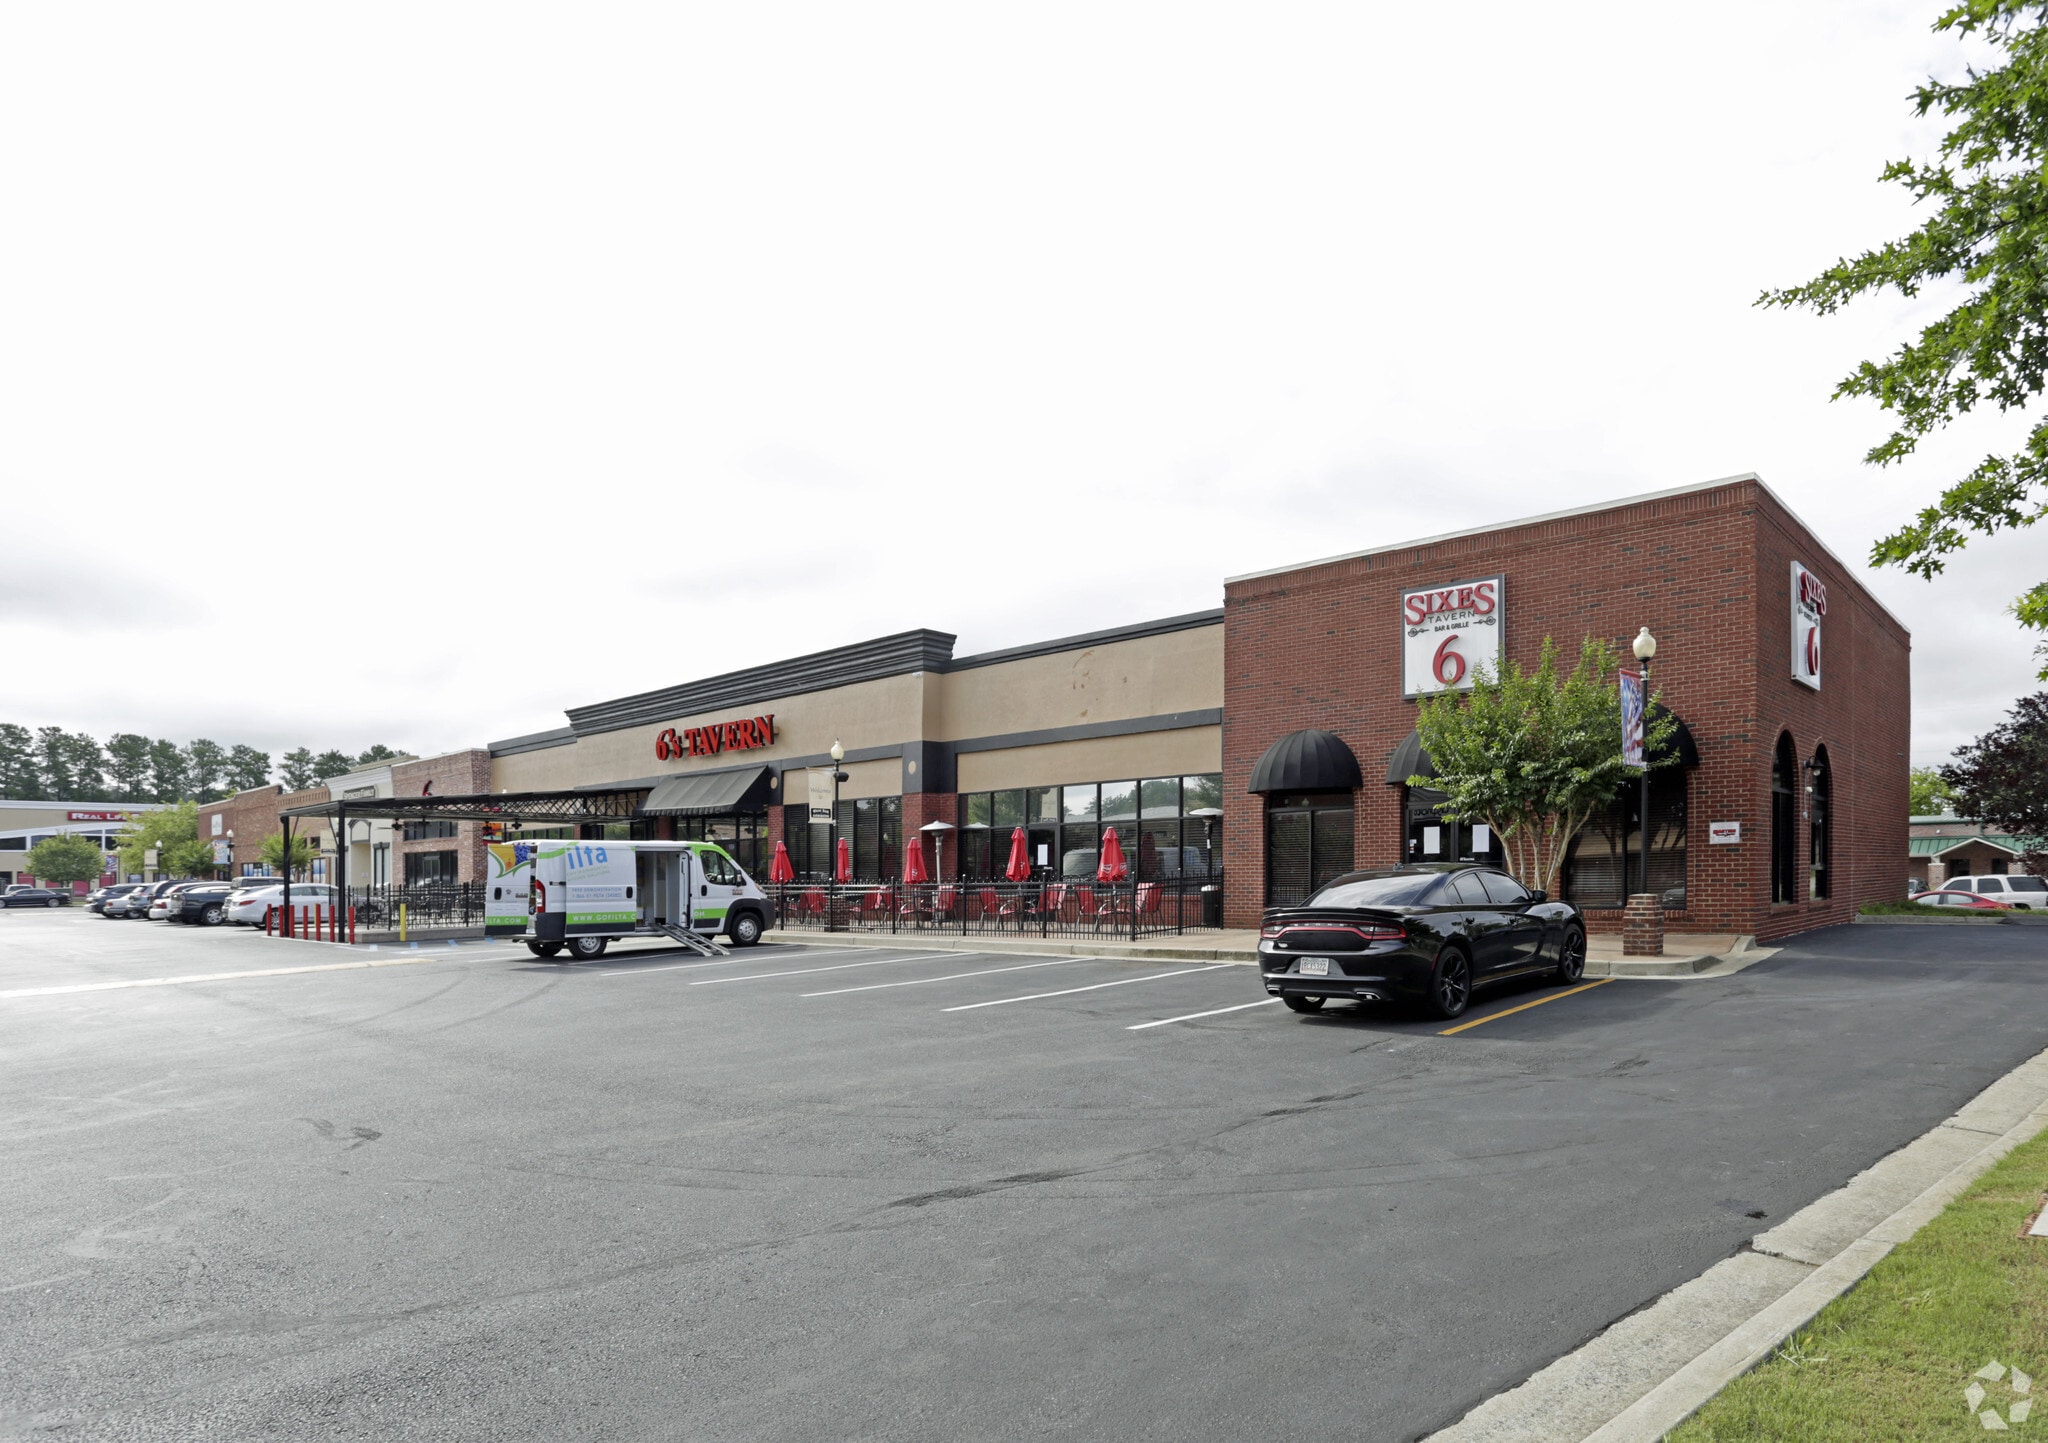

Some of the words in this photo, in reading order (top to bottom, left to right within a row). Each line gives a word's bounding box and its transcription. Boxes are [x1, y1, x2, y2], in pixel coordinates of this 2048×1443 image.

[1404, 582, 1494, 626] SIXES
[1427, 610, 1475, 624] TAVERN
[1451, 621, 1470, 630] GRILLE
[1432, 633, 1466, 685] 6
[1806, 626, 1819, 676] 6
[684, 714, 775, 757] TAVERN
